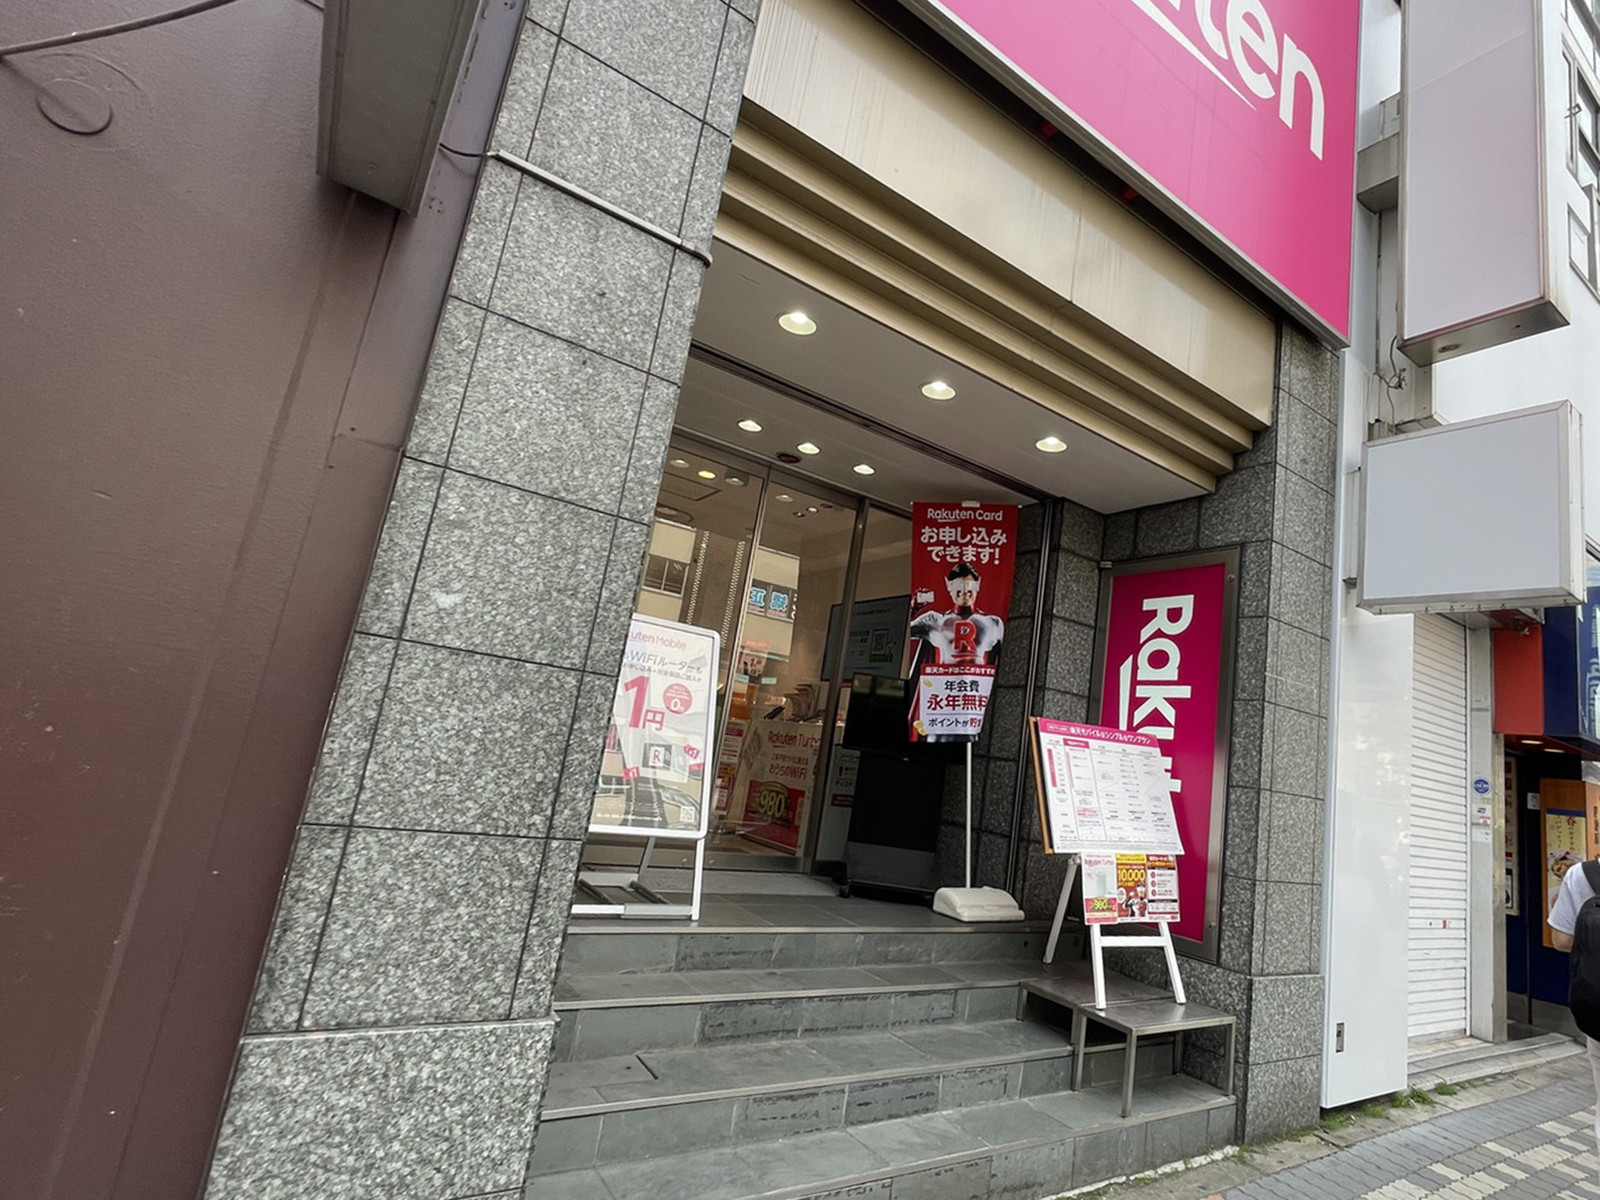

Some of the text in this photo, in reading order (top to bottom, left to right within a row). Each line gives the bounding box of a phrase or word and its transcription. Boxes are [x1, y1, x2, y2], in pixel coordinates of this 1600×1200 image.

[927, 508, 1003, 522] Rakuten Card
[921, 526, 1007, 545] お申し込み
[927, 545, 1000, 565] できます!
[656, 636, 687, 649] Mobile
[954, 620, 977, 651] R
[944, 680, 979, 692] 年会費
[624, 676, 665, 731] 1円
[768, 731, 797, 748] Rakuten
